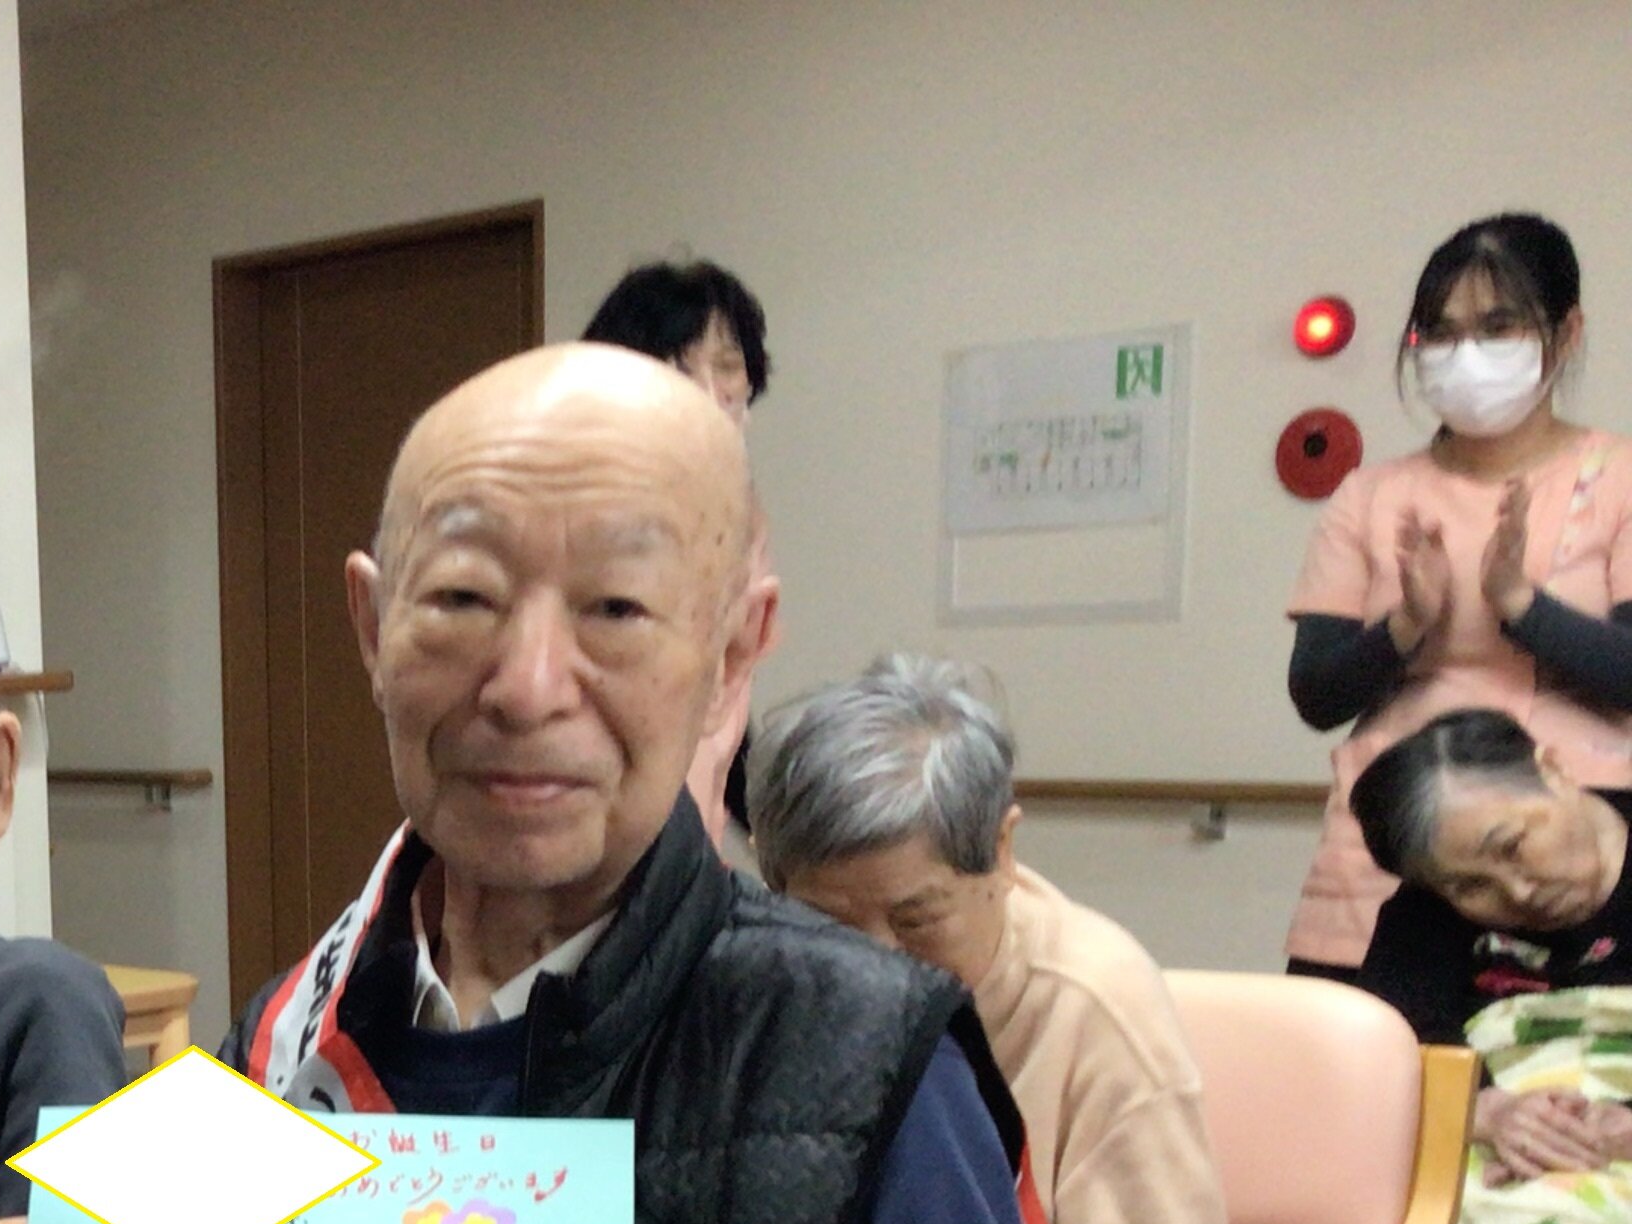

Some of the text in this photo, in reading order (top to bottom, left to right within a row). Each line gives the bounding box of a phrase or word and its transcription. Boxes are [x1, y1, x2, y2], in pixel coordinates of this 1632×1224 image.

[329, 1166, 568, 1206] めでとうございます
